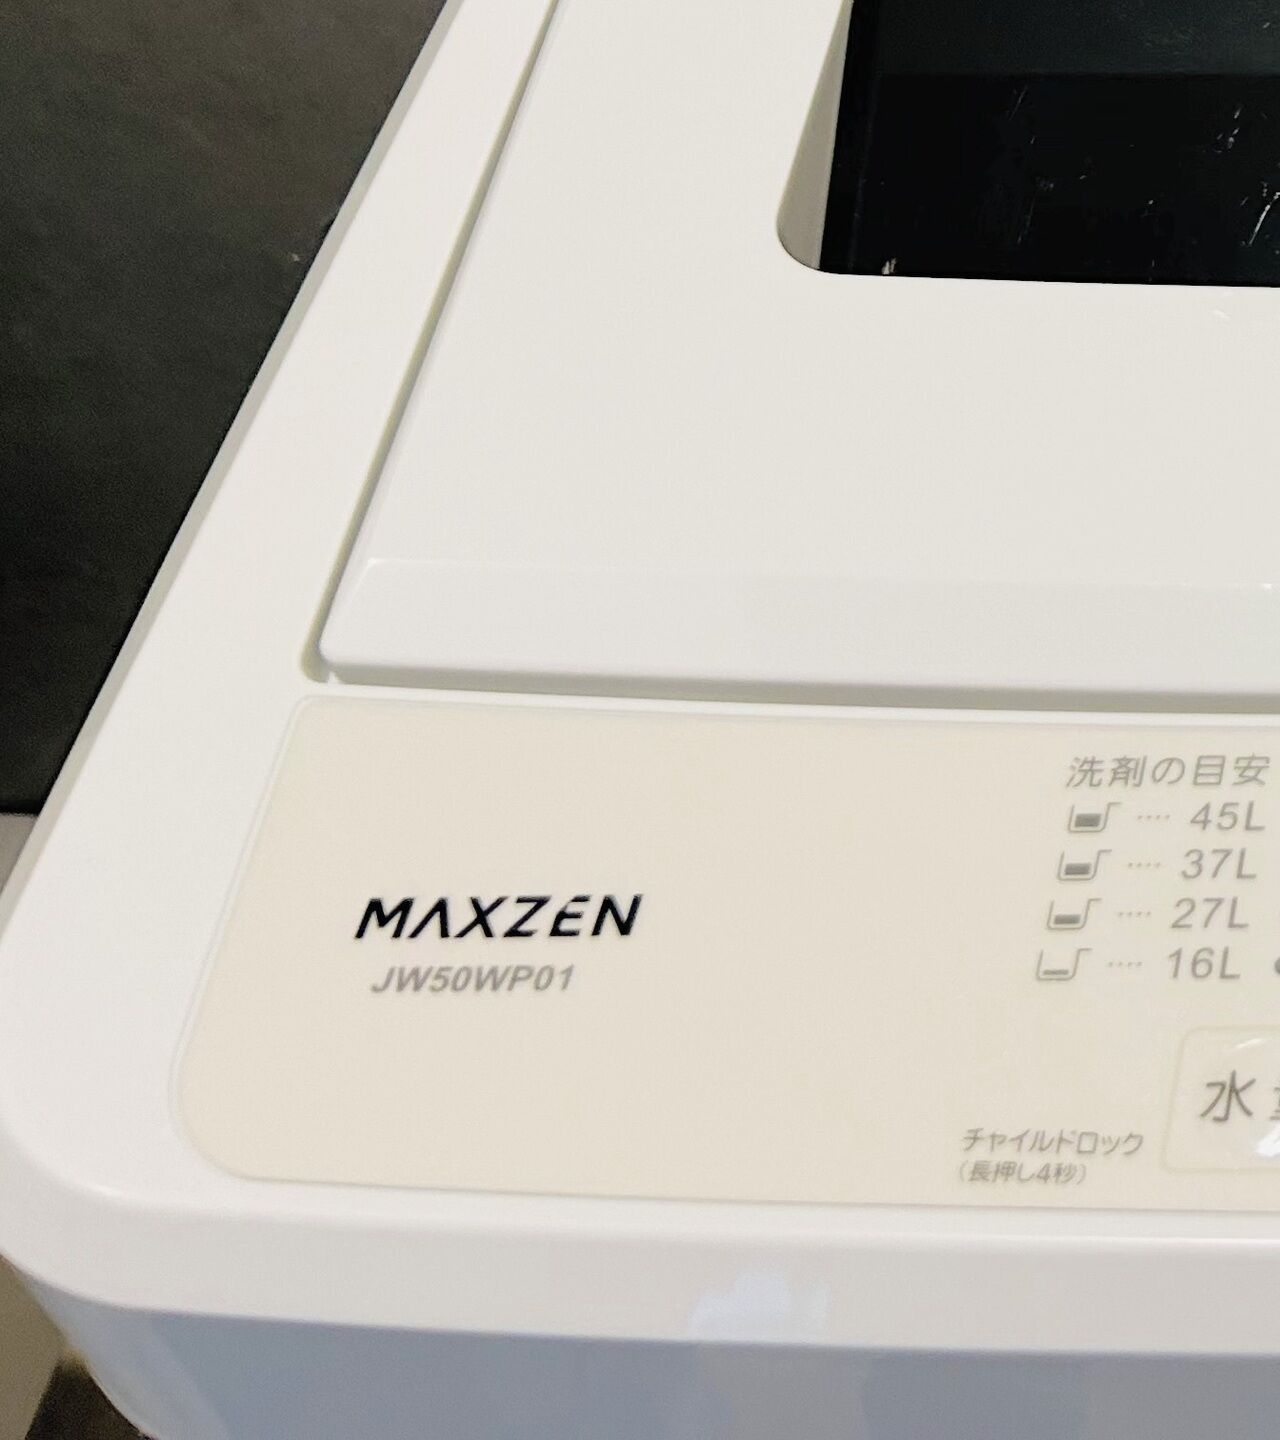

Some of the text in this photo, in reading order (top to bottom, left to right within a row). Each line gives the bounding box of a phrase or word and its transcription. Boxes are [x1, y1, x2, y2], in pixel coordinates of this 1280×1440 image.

[1065, 753, 1271, 788] 洗剤の目安
[1189, 800, 1266, 832] 45L
[1180, 847, 1257, 881] 37L
[354, 893, 643, 941] MAXZEN
[1169, 896, 1250, 931] 27L
[370, 963, 575, 995] JW50WP01
[1168, 946, 1241, 981] 16L
[963, 1127, 1144, 1156] チャイルドロック
[959, 1160, 1087, 1186] (長押し4秒)
